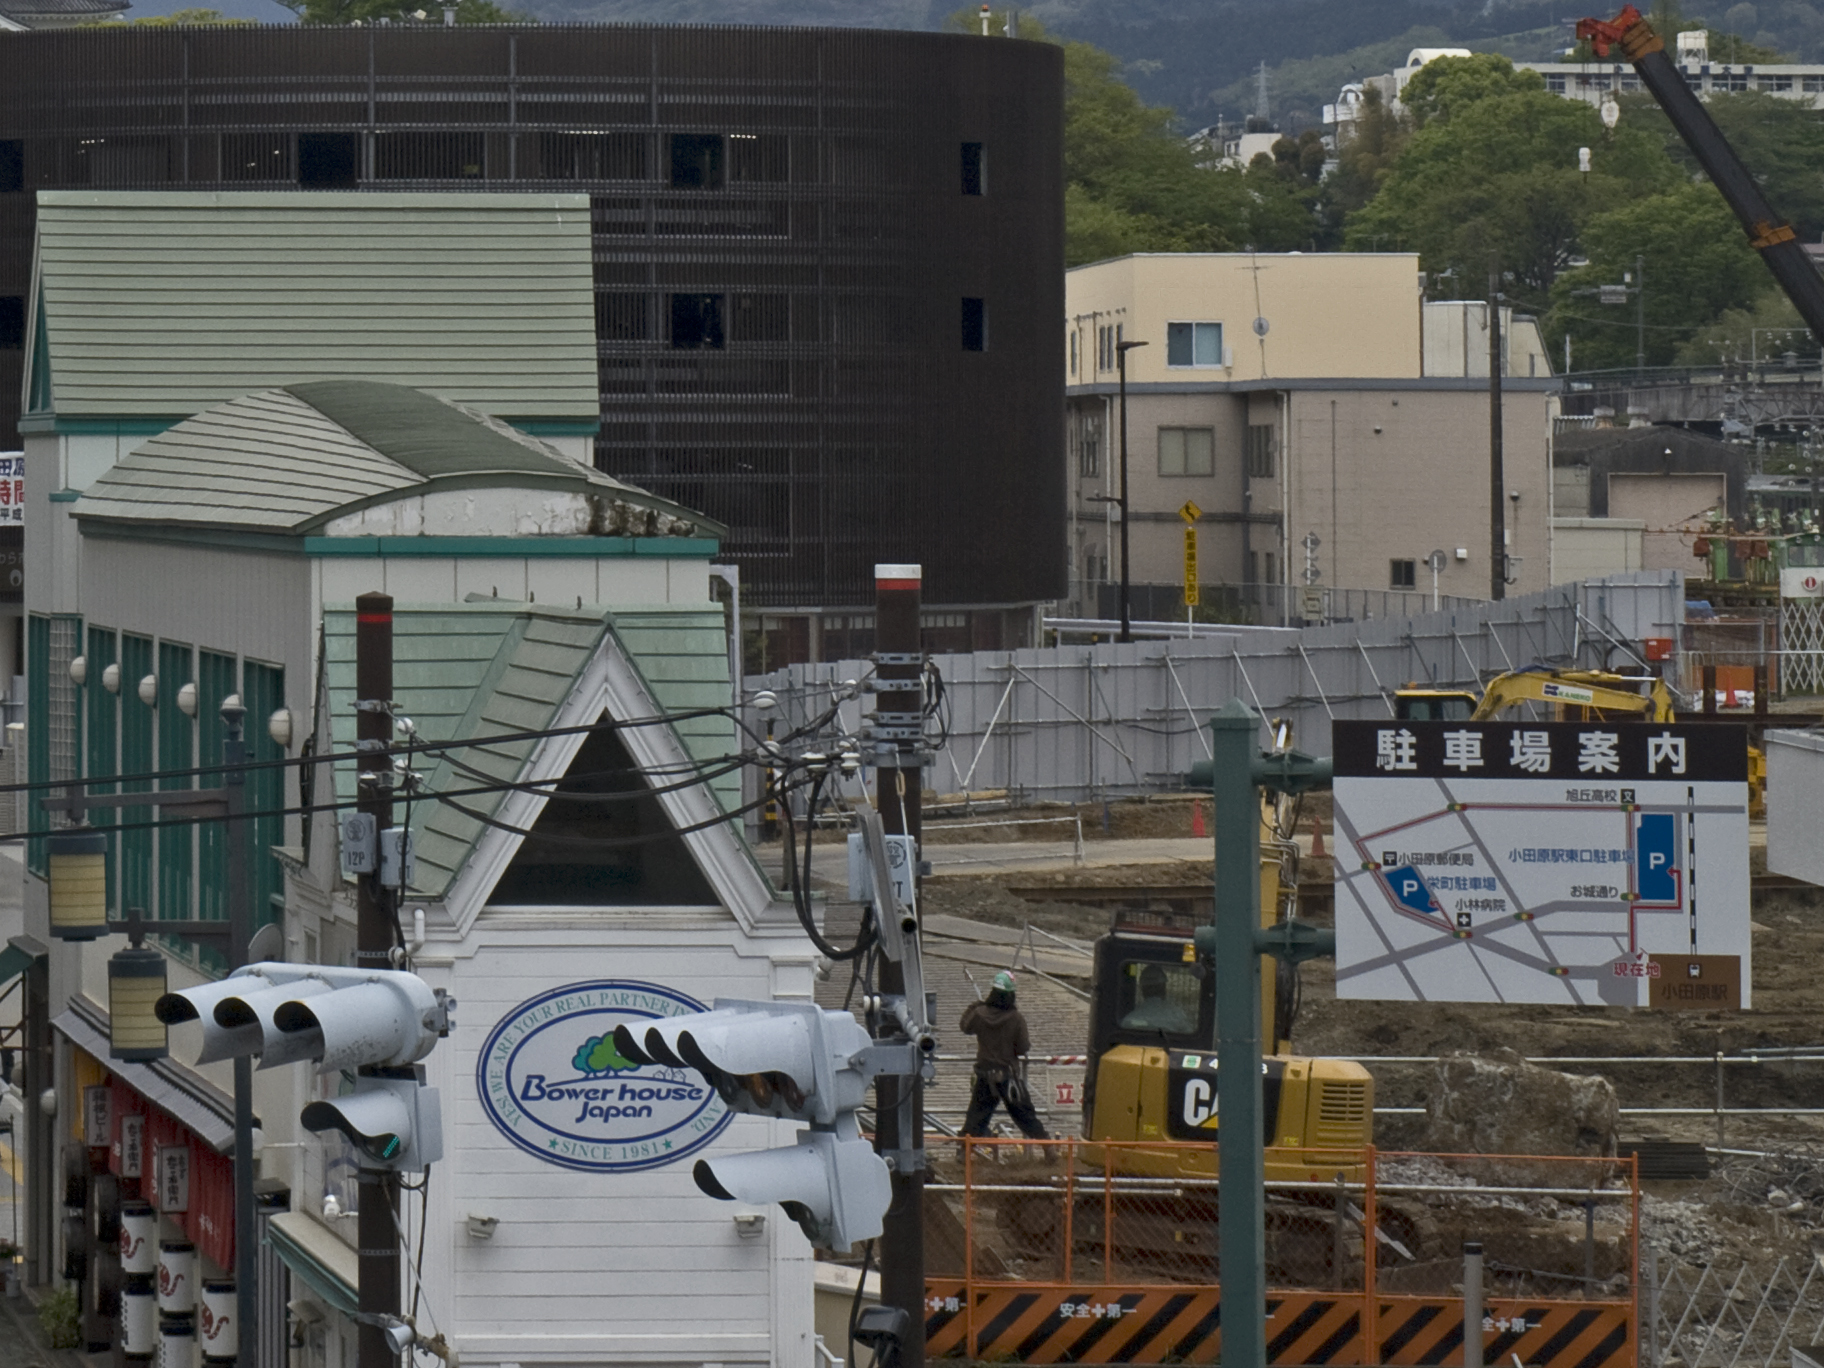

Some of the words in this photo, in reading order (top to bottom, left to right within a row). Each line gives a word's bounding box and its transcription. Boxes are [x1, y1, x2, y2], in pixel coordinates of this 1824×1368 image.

[1376, 728, 1687, 774] 駐車場案内
[1565, 789, 1617, 803] 旭丘高校
[1398, 852, 1474, 867] 小田原郵便局
[1508, 848, 1635, 864] 小田原駅東口駐車場
[1649, 852, 1666, 870] P
[1403, 880, 1418, 897] P
[1570, 885, 1619, 899] お城通り
[1455, 898, 1506, 912] 小林病院
[1613, 962, 1661, 978] 現在地
[1661, 984, 1727, 1001] 小田原駅
[493, 1036, 517, 1069] ARE
[513, 1005, 554, 1034] YOUR
[557, 993, 597, 1014] REAL
[600, 992, 670, 1016] PARTNER
[520, 1074, 613, 1101] Bower
[618, 1083, 704, 1101] house
[575, 1101, 653, 1123] Japan
[561, 1140, 613, 1160] SINCE
[621, 1143, 659, 1160] 1981
